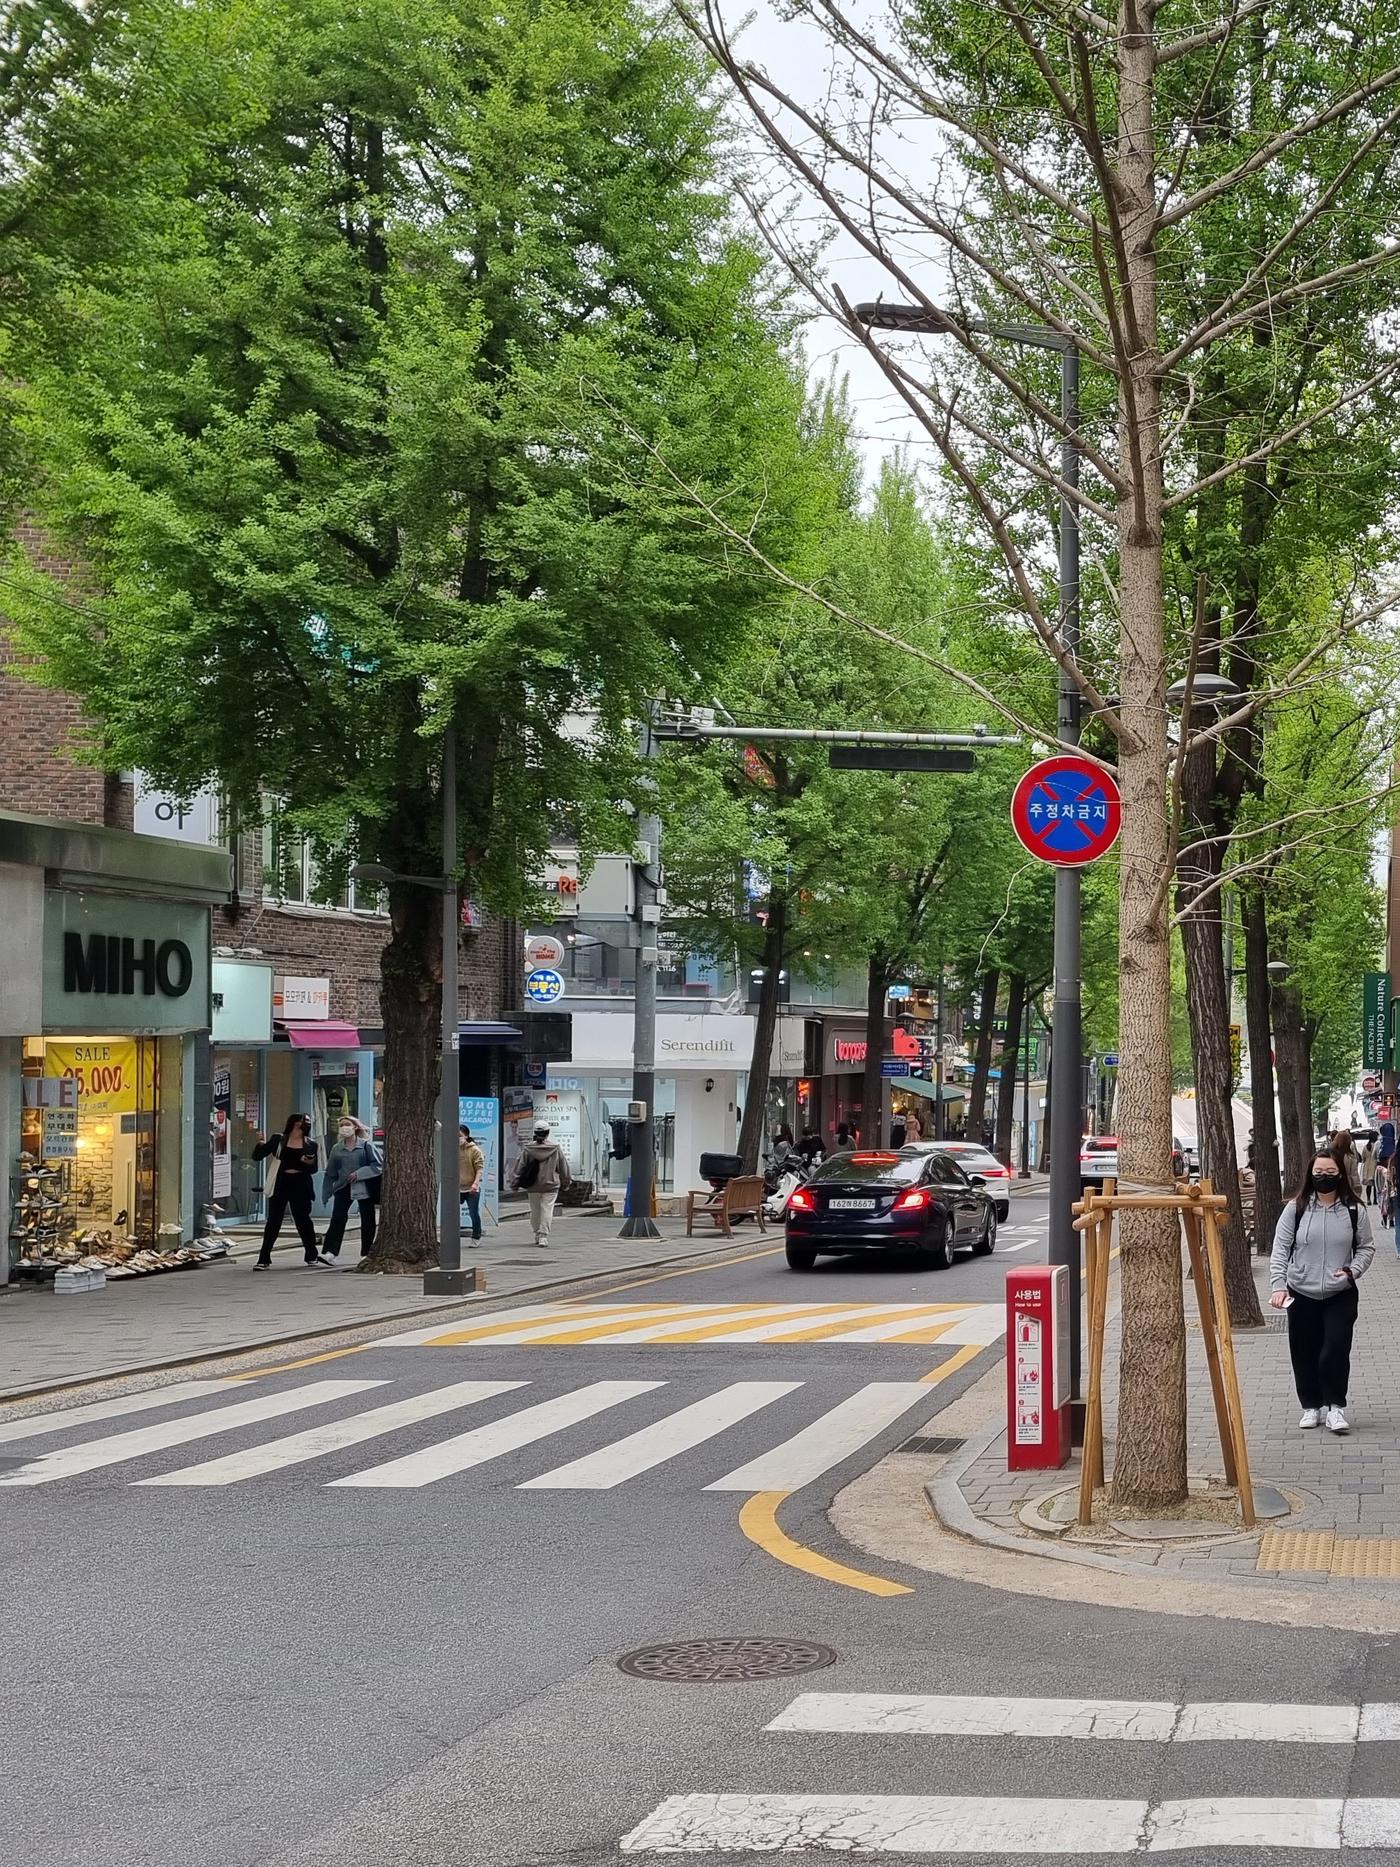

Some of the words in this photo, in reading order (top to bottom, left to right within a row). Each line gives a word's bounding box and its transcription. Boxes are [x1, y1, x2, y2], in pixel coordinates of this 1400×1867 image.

[1029, 803, 1107, 820] 주정차금지
[64, 932, 193, 997] MIHO
[529, 982, 560, 993] 부동산
[1377, 978, 1386, 1012] Nature
[1376, 1014, 1386, 1063] Collection
[74, 1046, 110, 1061] SALE
[23, 1079, 74, 1107] LE
[1014, 1289, 1042, 1300] 사용법
